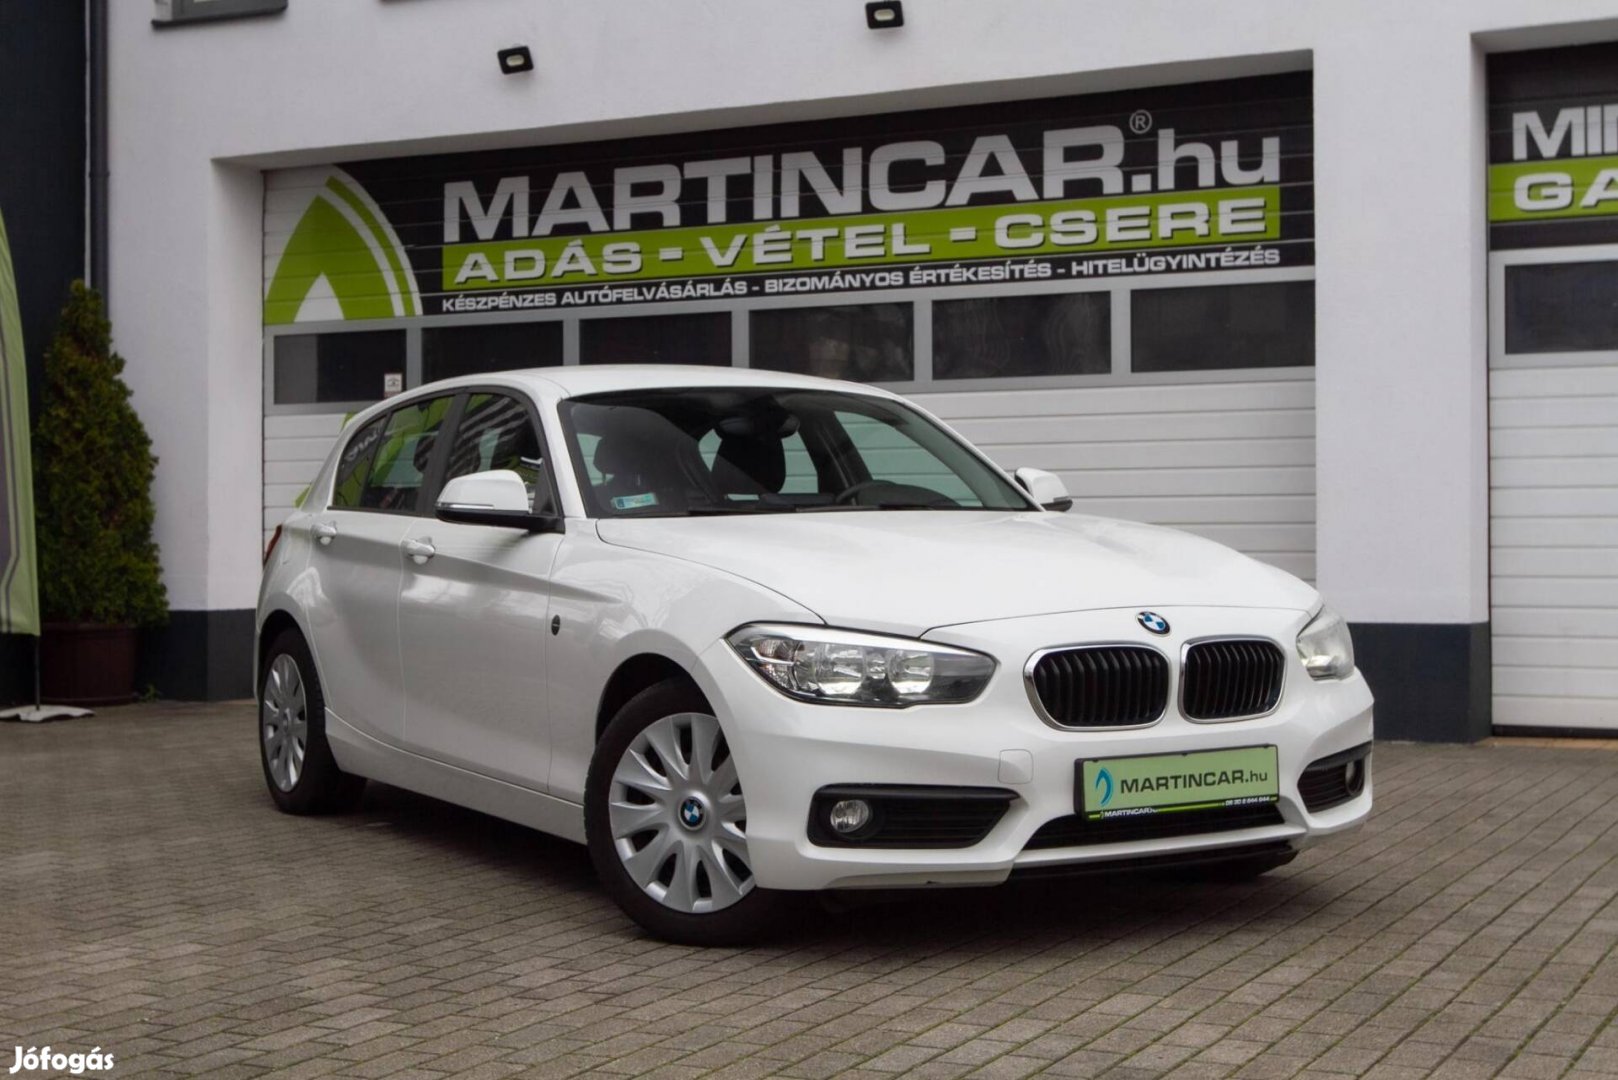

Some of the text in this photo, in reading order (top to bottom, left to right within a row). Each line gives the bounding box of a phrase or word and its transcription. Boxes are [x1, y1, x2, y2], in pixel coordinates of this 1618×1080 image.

[454, 239, 643, 284] ADÁS
[700, 223, 931, 267] VÉTEL
[994, 198, 1267, 249] CSERE
[442, 291, 557, 312] KÉSZPÉNZES
[561, 278, 748, 305] AUTÓFELVÁSÁRLÁS
[764, 271, 904, 295] BIZOMÁNYOS
[909, 259, 1052, 285] ÉRTÉKESÍTÉS
[1071, 247, 1281, 276] HITELÜGYINTÉZÉS
[1120, 769, 1268, 794] MARTINCAR.hu
